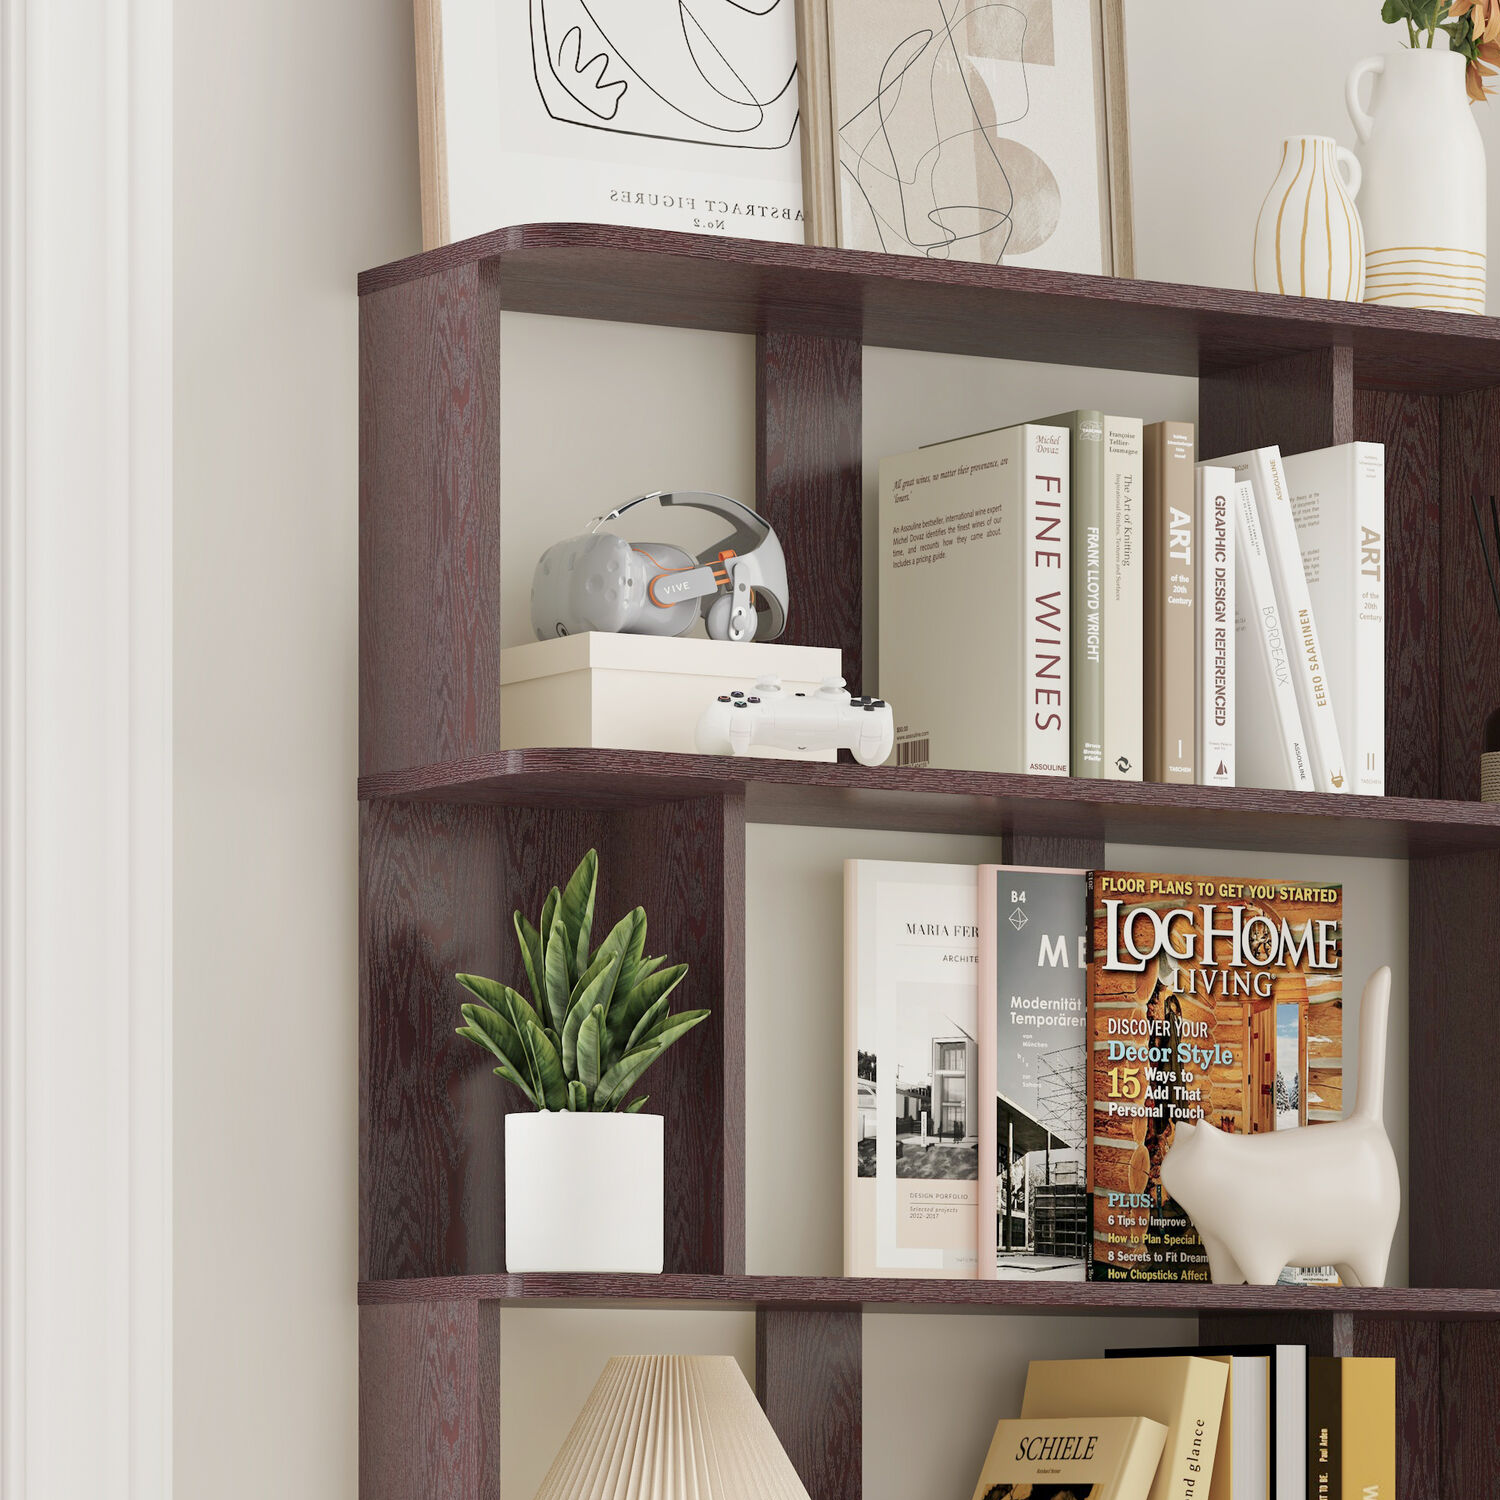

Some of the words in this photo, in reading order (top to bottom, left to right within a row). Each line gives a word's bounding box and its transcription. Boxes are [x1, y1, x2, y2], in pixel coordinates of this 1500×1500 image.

[1036, 435, 1061, 445] Michel
[1036, 445, 1059, 454] Dovaz
[1124, 474, 1132, 493] The
[1124, 496, 1132, 511] Art
[1035, 475, 1061, 568] FINE
[1124, 514, 1132, 523] of
[1214, 495, 1226, 563] GRAPHIC
[1087, 527, 1099, 567] FRANK
[1122, 525, 1132, 567] Knitting
[1169, 507, 1191, 566] ART
[1361, 526, 1381, 582] ART
[664, 581, 690, 594] VIVE
[1087, 568, 1099, 610] LLOYD
[1171, 575, 1178, 583] of
[1173, 586, 1187, 594] 20th
[1168, 596, 1192, 607] Century
[1214, 568, 1226, 622] DESIGN
[1087, 613, 1099, 662] WRIGHT
[1262, 605, 1289, 687] BORDEAUX
[1298, 608, 1320, 672] SAARINEN
[1035, 591, 1061, 730] WINES
[1214, 627, 1226, 727] REFERENCED
[1312, 675, 1327, 707] EERO
[1029, 763, 1067, 772] ASSOULINE
[1011, 890, 1026, 903] B4
[1102, 877, 1145, 893] FLOOR
[1150, 879, 1192, 895] PLANS
[1198, 882, 1215, 896] TO
[1219, 883, 1244, 898] GET
[1249, 885, 1275, 900] YOU
[1280, 886, 1337, 903] STARTED
[905, 923, 949, 937] MARIA
[942, 955, 979, 963] ARCHITE
[1173, 968, 1274, 997] LIVING
[1010, 996, 1081, 1011] Modernität
[1010, 1011, 1086, 1028] Temporären
[1107, 1040, 1172, 1063] Decor
[1177, 1043, 1233, 1071] Style
[1016, 1435, 1098, 1462] SCHIELE
[1186, 1418, 1205, 1472] glance
